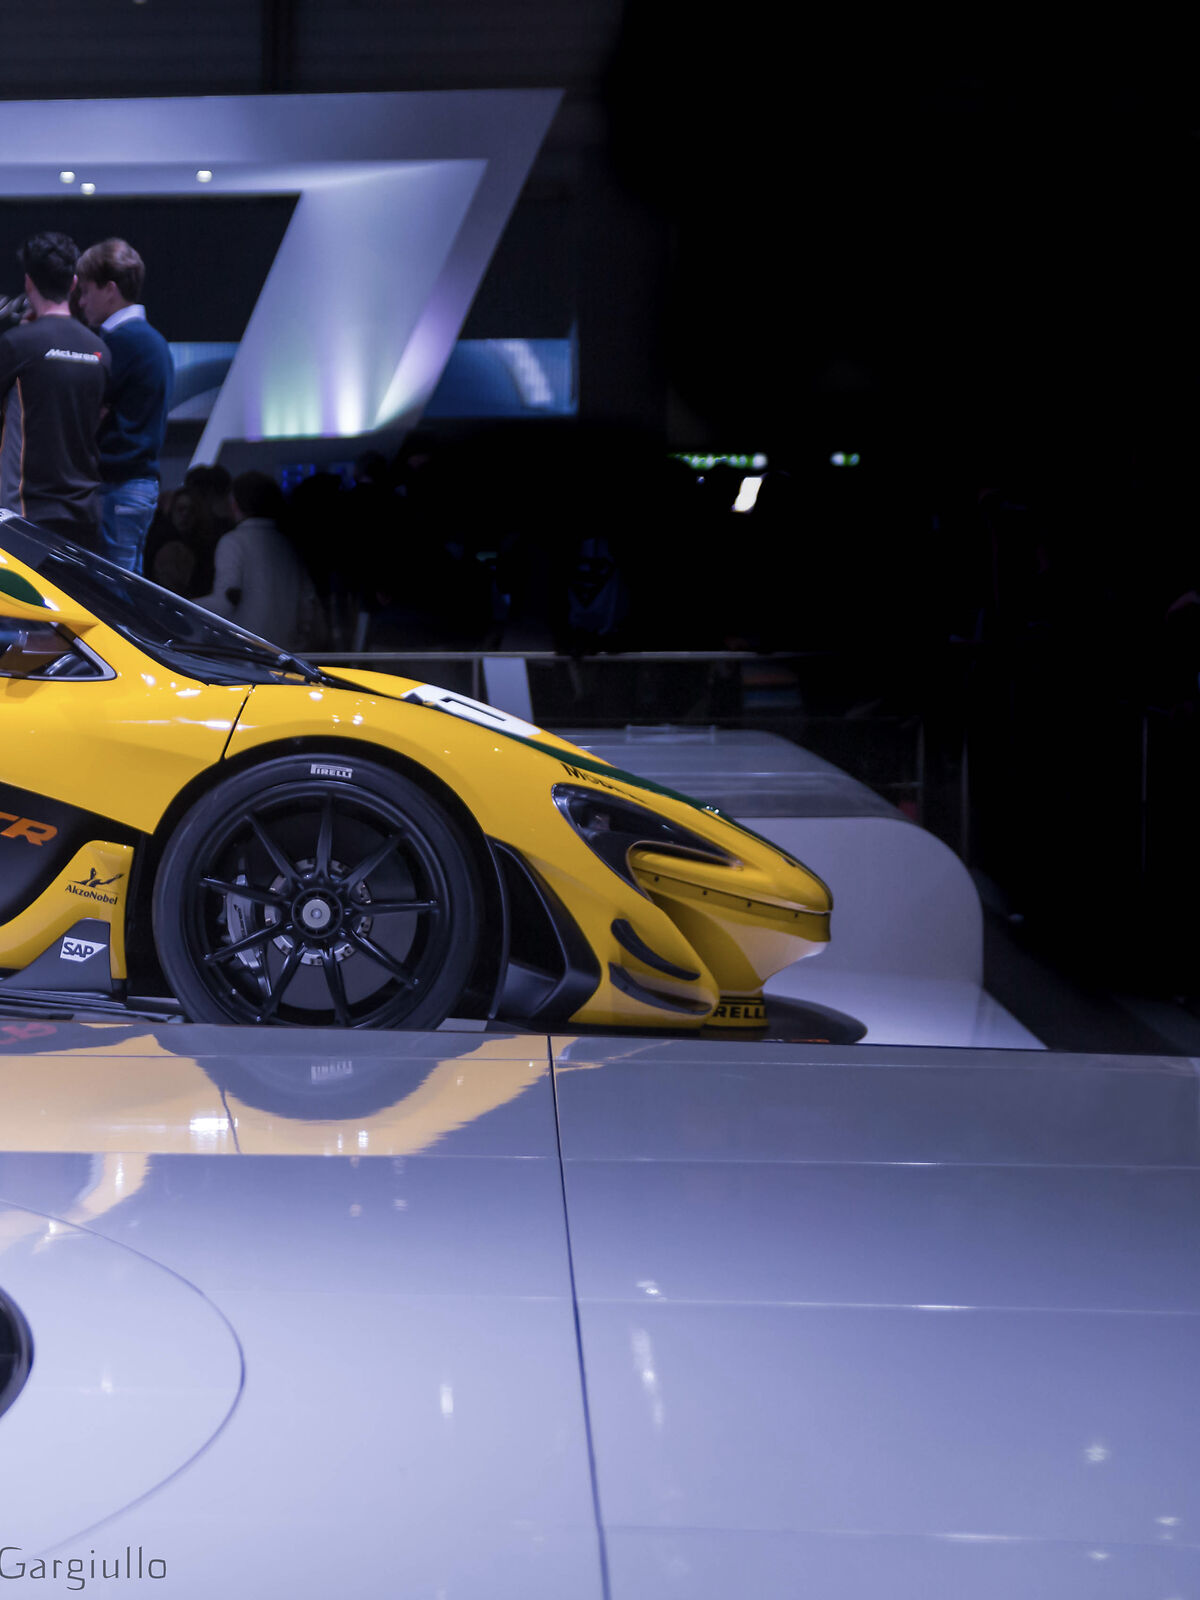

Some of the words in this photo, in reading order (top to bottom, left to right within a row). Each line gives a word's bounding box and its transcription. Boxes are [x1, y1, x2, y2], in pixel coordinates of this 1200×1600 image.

[310, 763, 353, 779] PIRELLI
[64, 884, 119, 905] AkzoNobel
[62, 941, 95, 958] SAP
